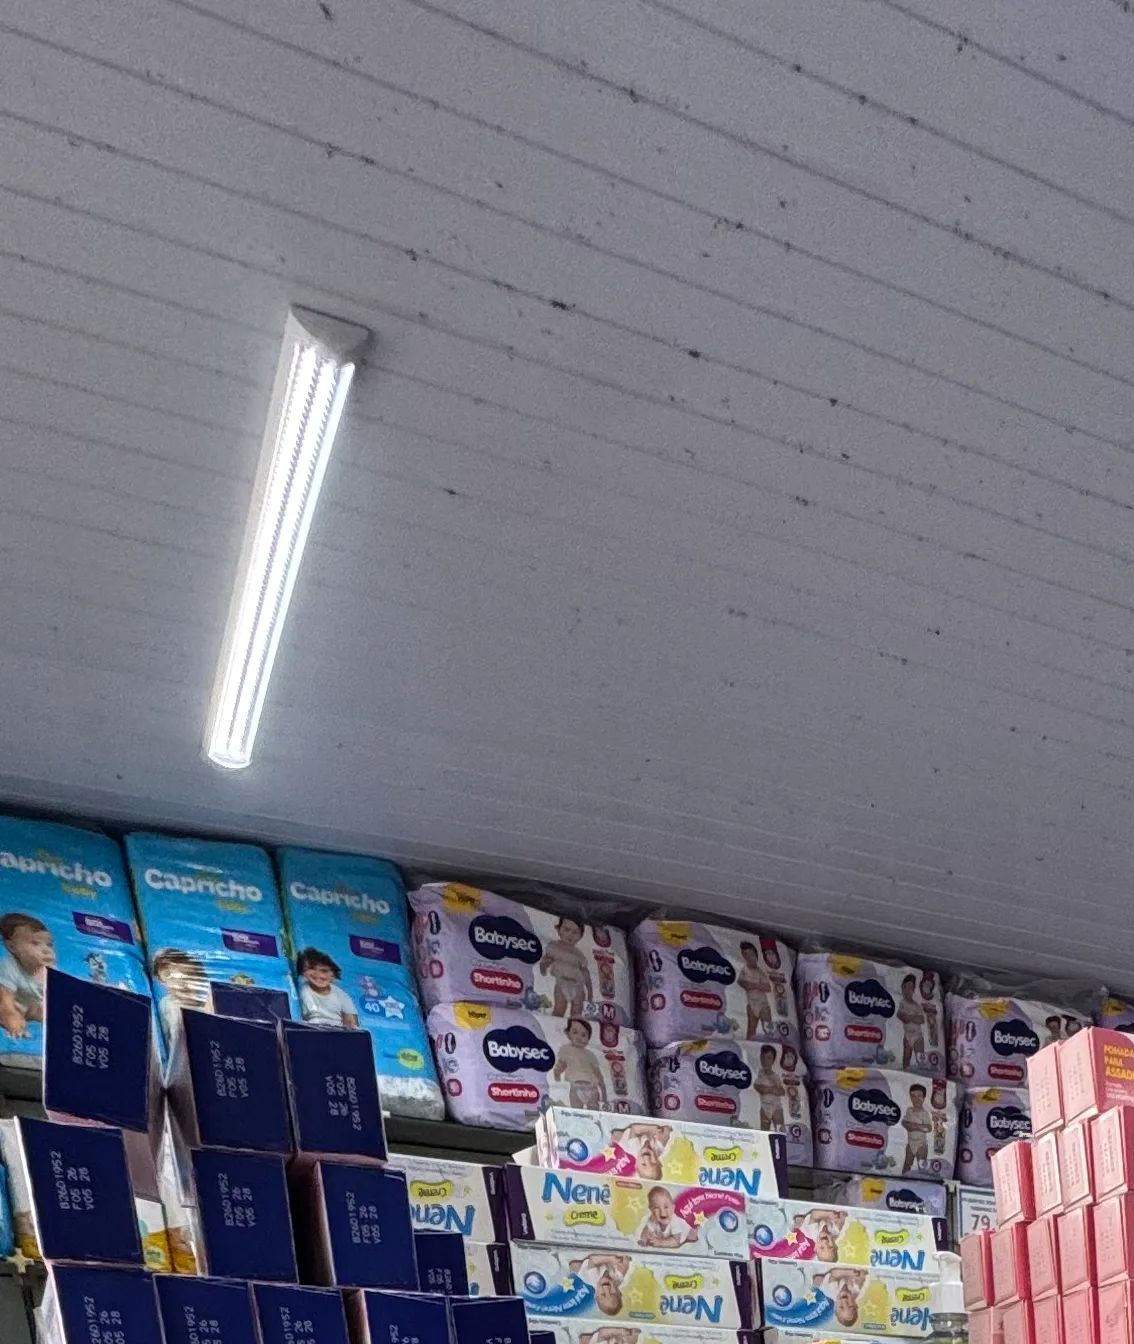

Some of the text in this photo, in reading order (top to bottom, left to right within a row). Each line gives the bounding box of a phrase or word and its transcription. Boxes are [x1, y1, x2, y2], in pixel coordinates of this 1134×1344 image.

[0, 851, 112, 888] apricho
[144, 868, 263, 902] Capricho
[289, 881, 390, 916] Capricho
[474, 927, 537, 953] Babysec
[681, 957, 731, 976] Babysec
[487, 1040, 549, 1061] Babysec
[994, 1033, 1036, 1047] Babysec
[699, 1061, 748, 1080] Babysec
[490, 1086, 538, 1099] Shortinho
[541, 1172, 611, 1204] Nenê
[571, 1210, 597, 1220] Creme
